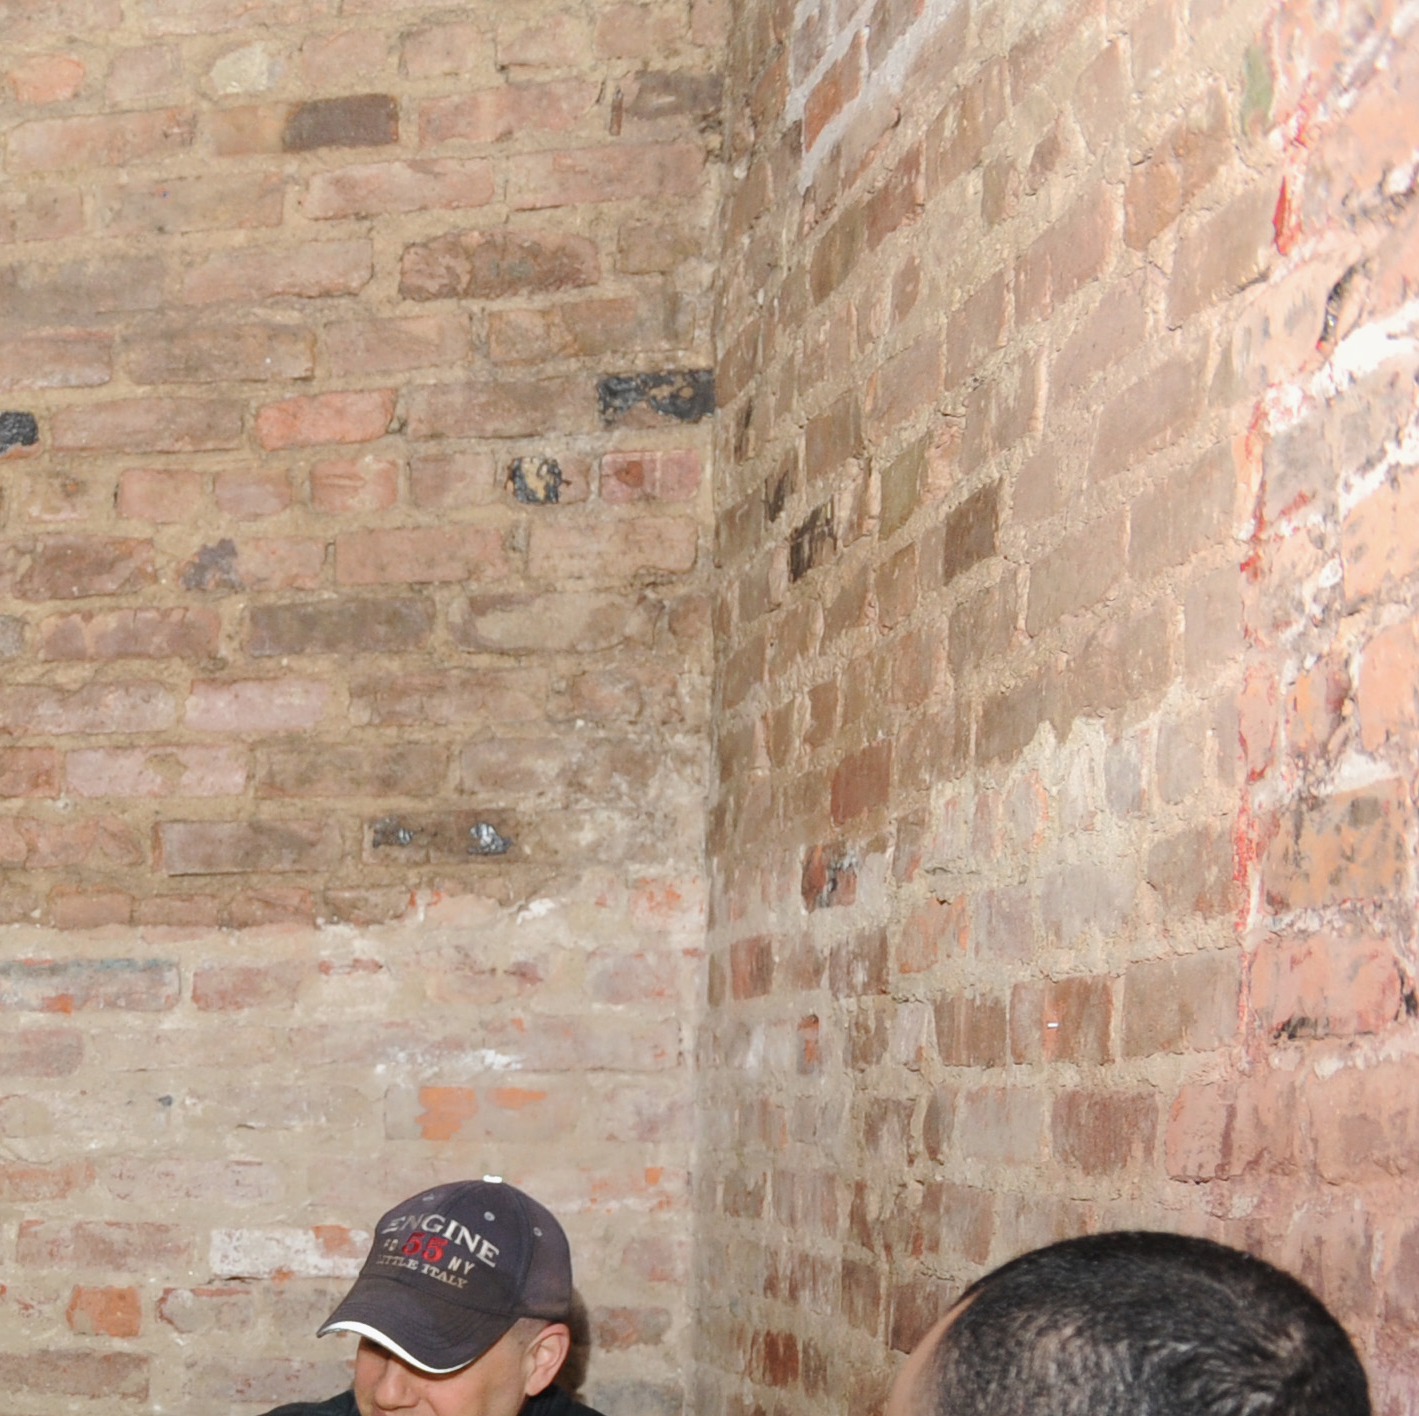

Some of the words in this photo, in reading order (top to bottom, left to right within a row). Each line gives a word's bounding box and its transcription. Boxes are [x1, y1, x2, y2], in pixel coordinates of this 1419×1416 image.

[381, 1213, 500, 1268] ENGINE
[402, 1231, 449, 1262] 55
[421, 1262, 469, 1288] ITALY
